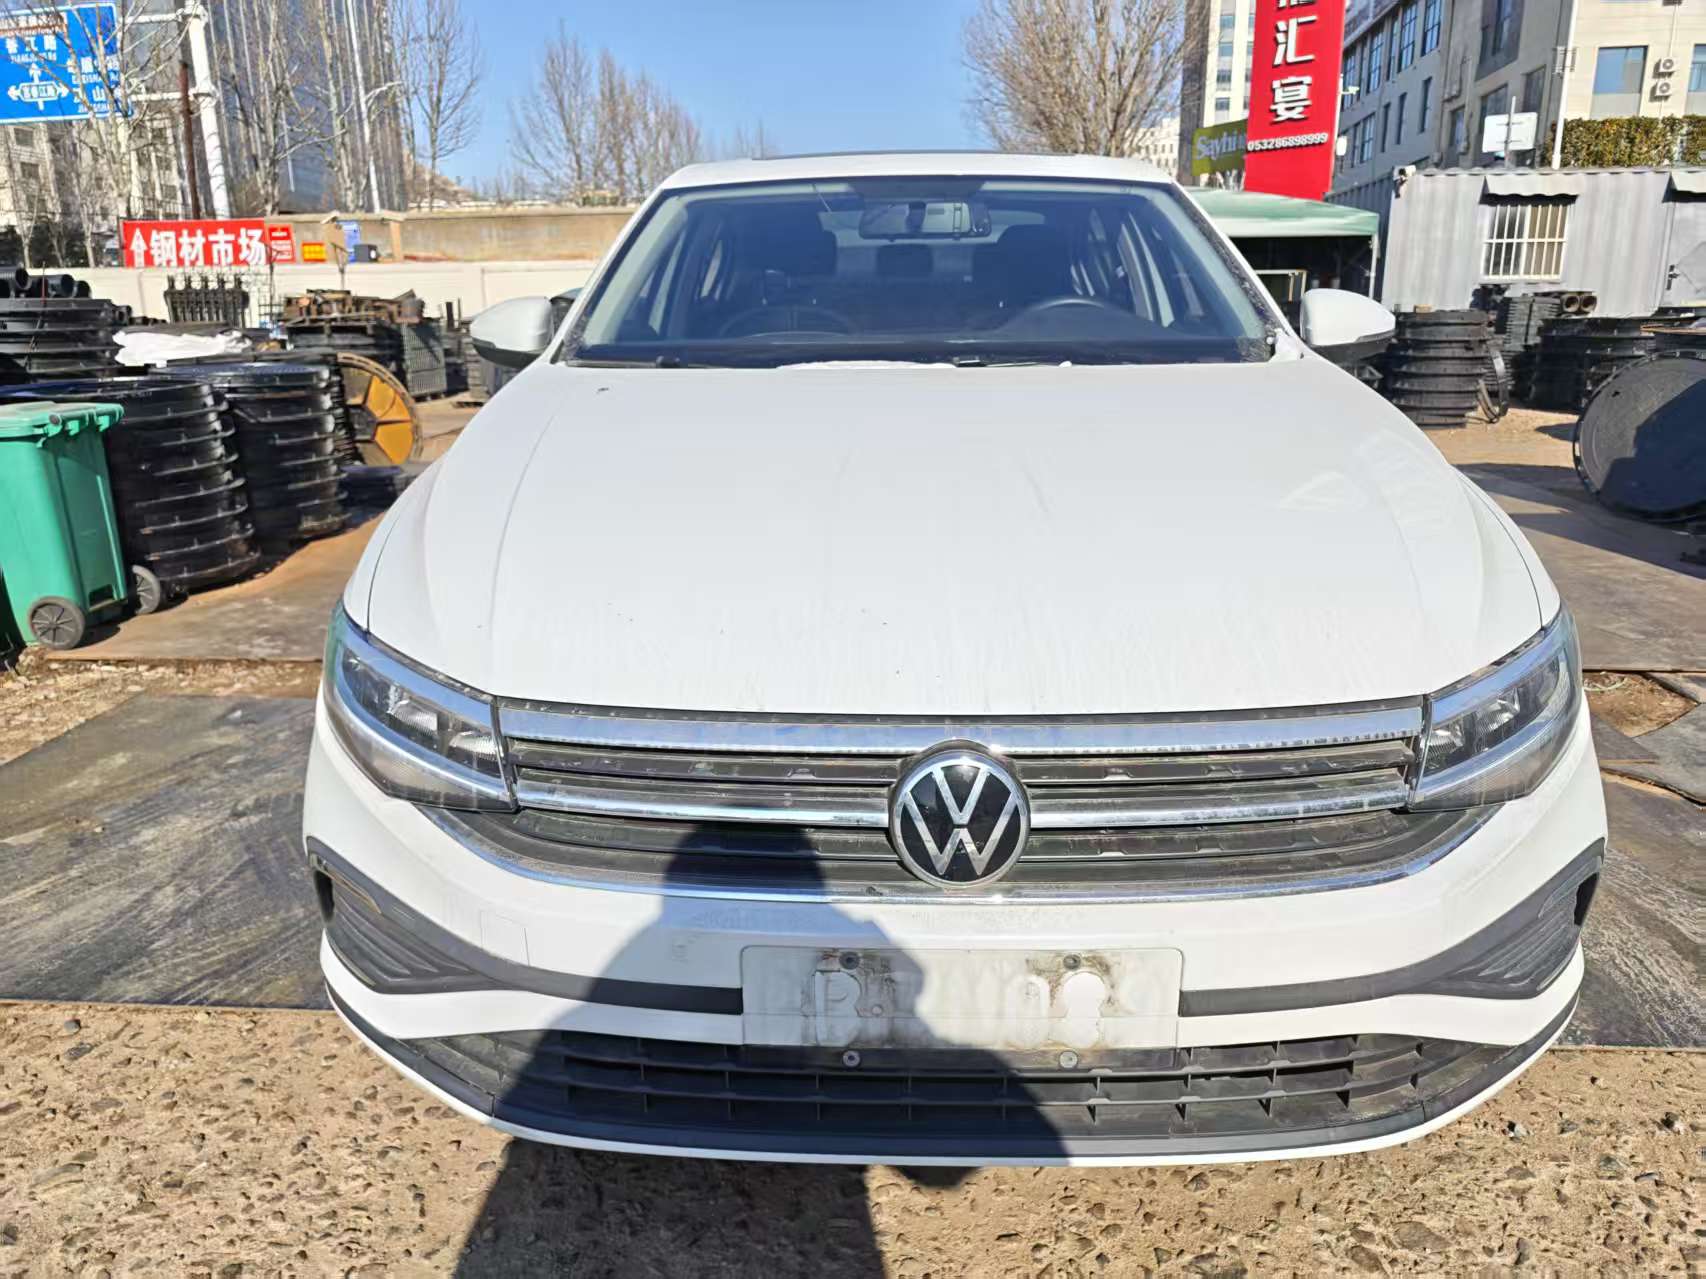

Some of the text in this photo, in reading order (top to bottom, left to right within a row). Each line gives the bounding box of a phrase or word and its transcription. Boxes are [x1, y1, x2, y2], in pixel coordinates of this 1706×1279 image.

[1269, 0, 1318, 122] 汇宴
[151, 227, 267, 268] 钢材市场
